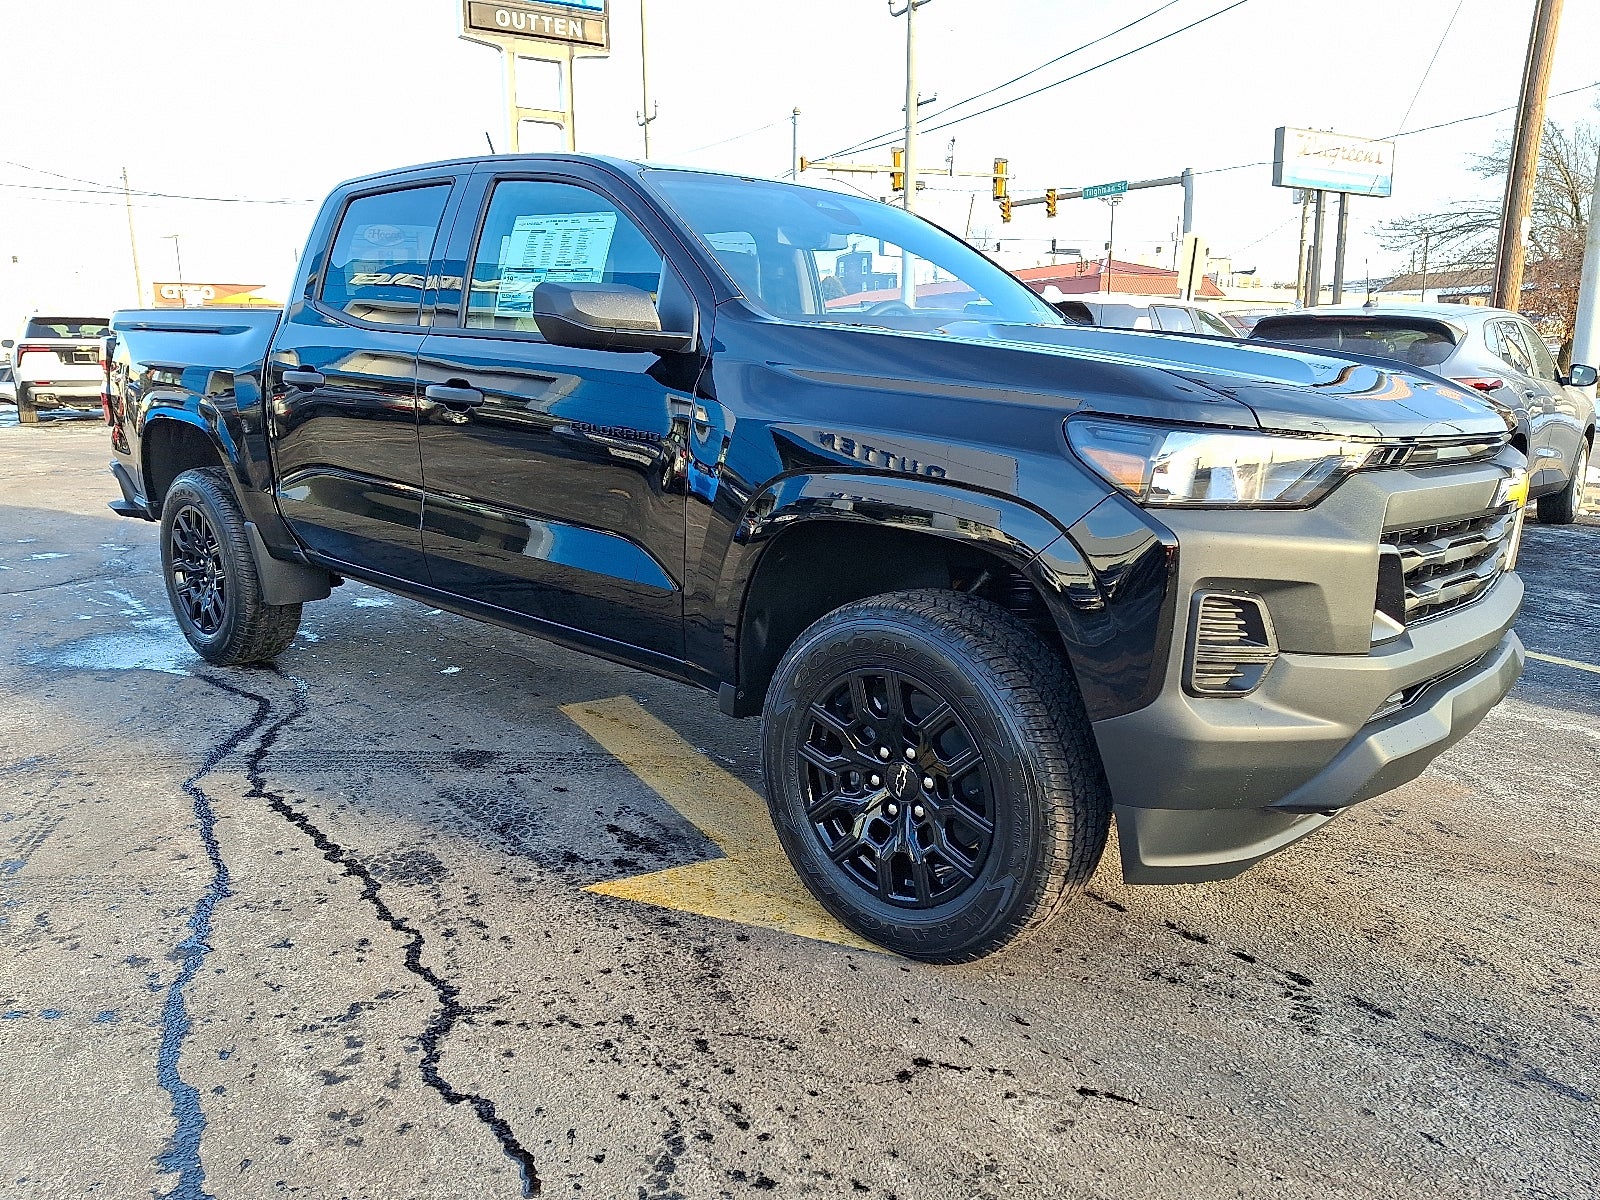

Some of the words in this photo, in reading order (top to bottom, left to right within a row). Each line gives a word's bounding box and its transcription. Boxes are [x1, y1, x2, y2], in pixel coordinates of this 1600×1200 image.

[495, 9, 583, 38] OUTTEN
[1085, 186, 1116, 198] Tilghman
[1117, 183, 1125, 191] St
[571, 421, 660, 442] COLORADO
[794, 636, 989, 718] GOODYEAR
